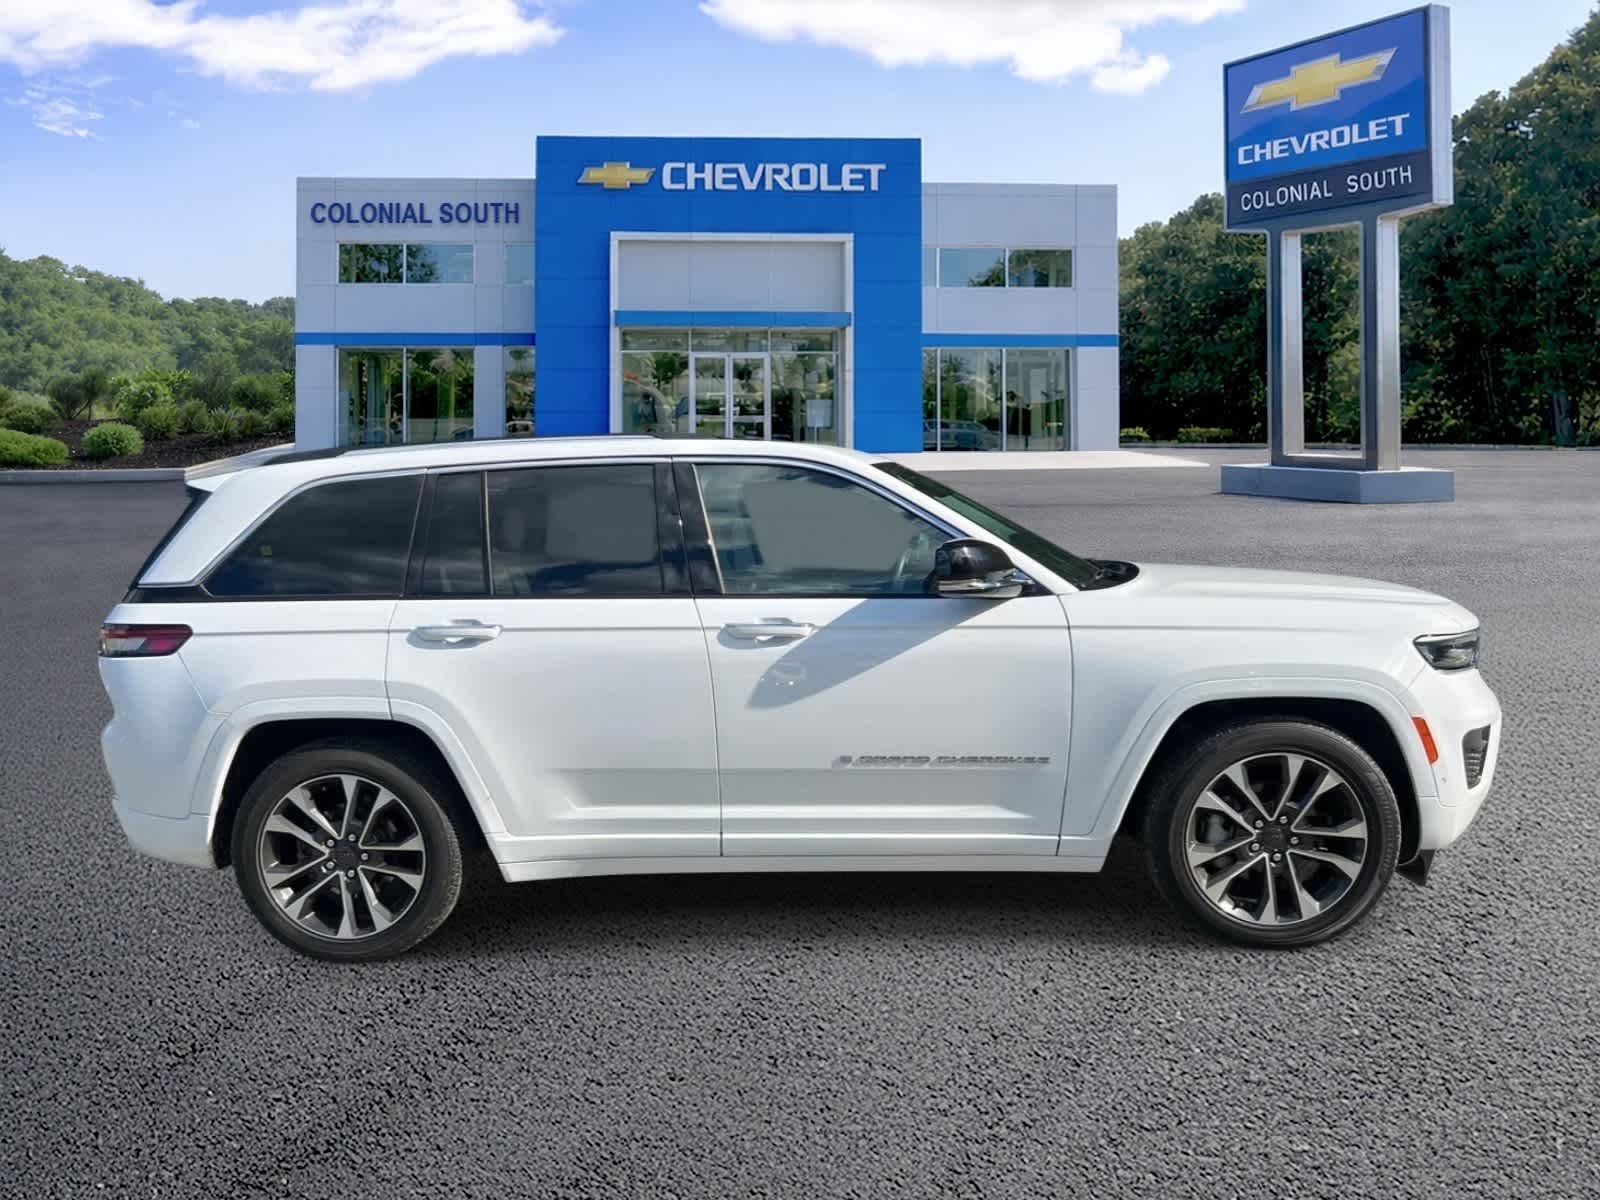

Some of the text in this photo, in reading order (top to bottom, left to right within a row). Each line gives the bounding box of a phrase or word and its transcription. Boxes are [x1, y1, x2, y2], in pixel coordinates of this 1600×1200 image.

[1237, 113, 1410, 165] CHEVROLET
[662, 162, 886, 192] CHEVROLET
[1240, 165, 1412, 211] COLONIAL SOUTH
[310, 202, 520, 225] COLONIAL SOUTH
